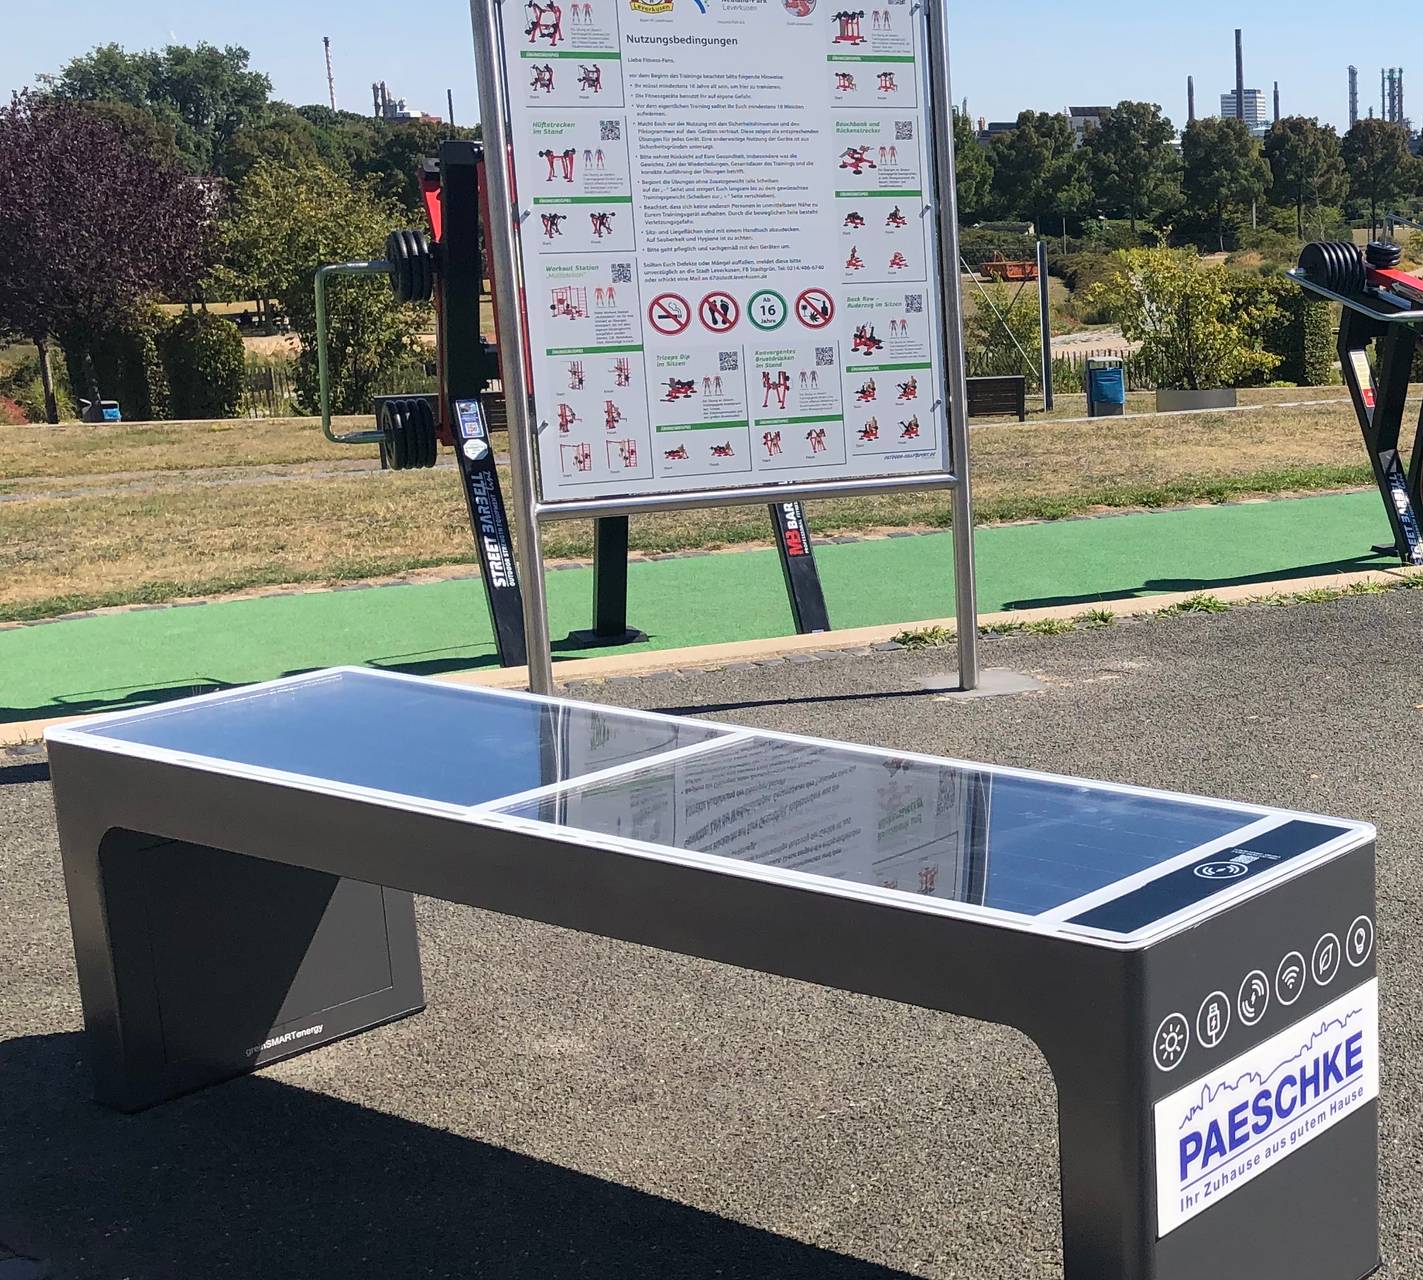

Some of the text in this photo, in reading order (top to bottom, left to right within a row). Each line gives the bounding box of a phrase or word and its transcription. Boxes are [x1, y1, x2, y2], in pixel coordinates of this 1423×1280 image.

[633, 4, 671, 13] Leverkusen
[626, 34, 738, 47] Nutzungsbedingungen
[760, 305, 776, 315] 16
[471, 472, 506, 587] STREET BARBELL
[783, 503, 798, 530] BAR
[504, 558, 515, 586] OUTDOOR
[1180, 1031, 1363, 1182] PAESCHKE
[1180, 1085, 1364, 1212] Ihr Zuhause aus gutem Hause
